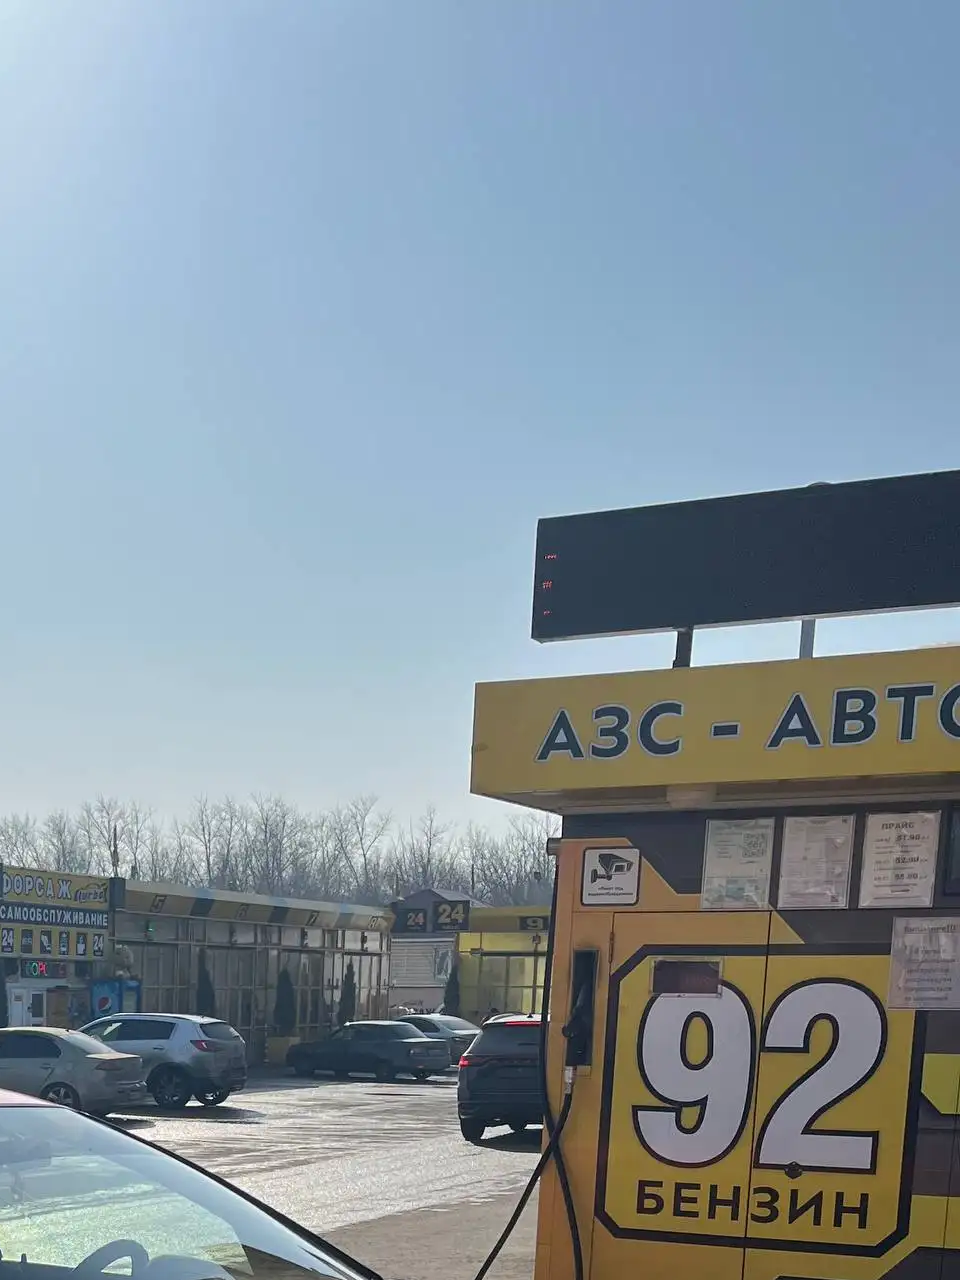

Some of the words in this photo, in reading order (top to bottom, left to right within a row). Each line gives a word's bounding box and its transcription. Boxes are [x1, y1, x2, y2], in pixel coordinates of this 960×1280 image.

[535, 700, 684, 762] АЗС
[407, 912, 424, 926] 24
[438, 904, 464, 923] 24
[527, 918, 543, 929] 9
[2, 930, 13, 947] 24
[94, 935, 104, 951] 24
[632, 977, 888, 1174] 92
[636, 1179, 870, 1230] БЕНЗИН
